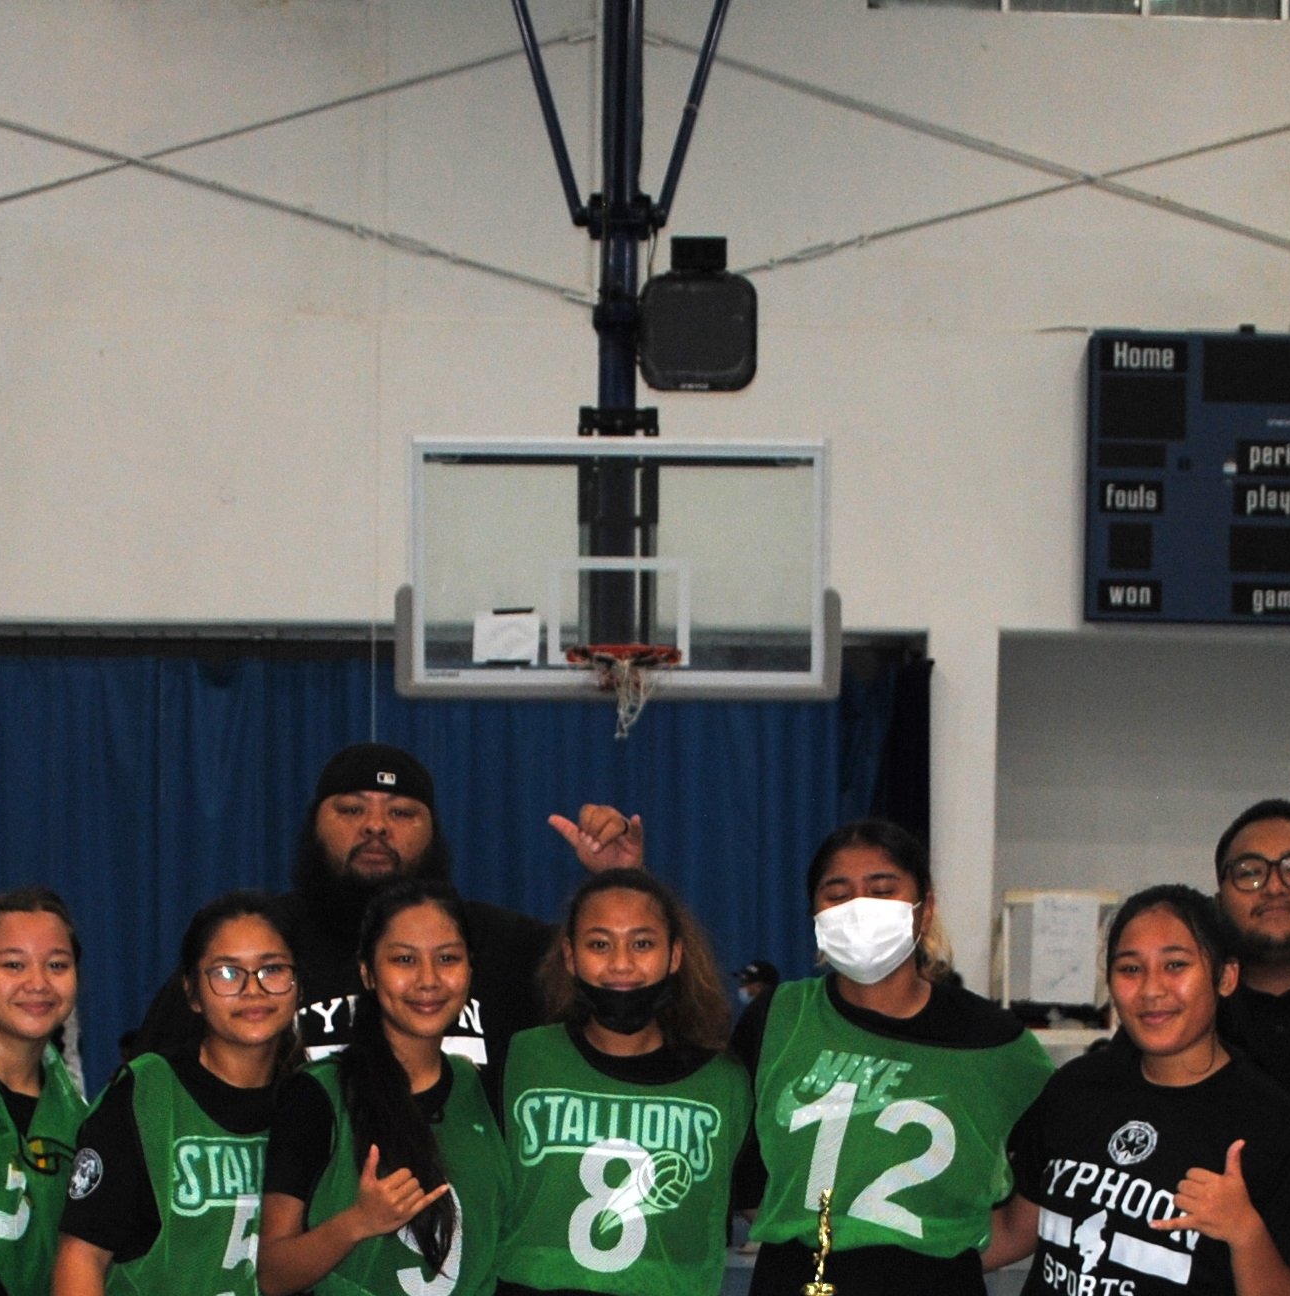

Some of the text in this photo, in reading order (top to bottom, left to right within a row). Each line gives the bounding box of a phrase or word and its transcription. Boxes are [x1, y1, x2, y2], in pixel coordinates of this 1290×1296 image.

[1113, 341, 1175, 369] Home
[1105, 483, 1158, 509] fouls
[1109, 585, 1152, 606] won
[797, 1050, 912, 1101] NIKE
[521, 1096, 714, 1171] STALLIONS
[789, 1081, 956, 1239] 12
[569, 1138, 656, 1273] 8
[1044, 1159, 1200, 1251] YPHOON
